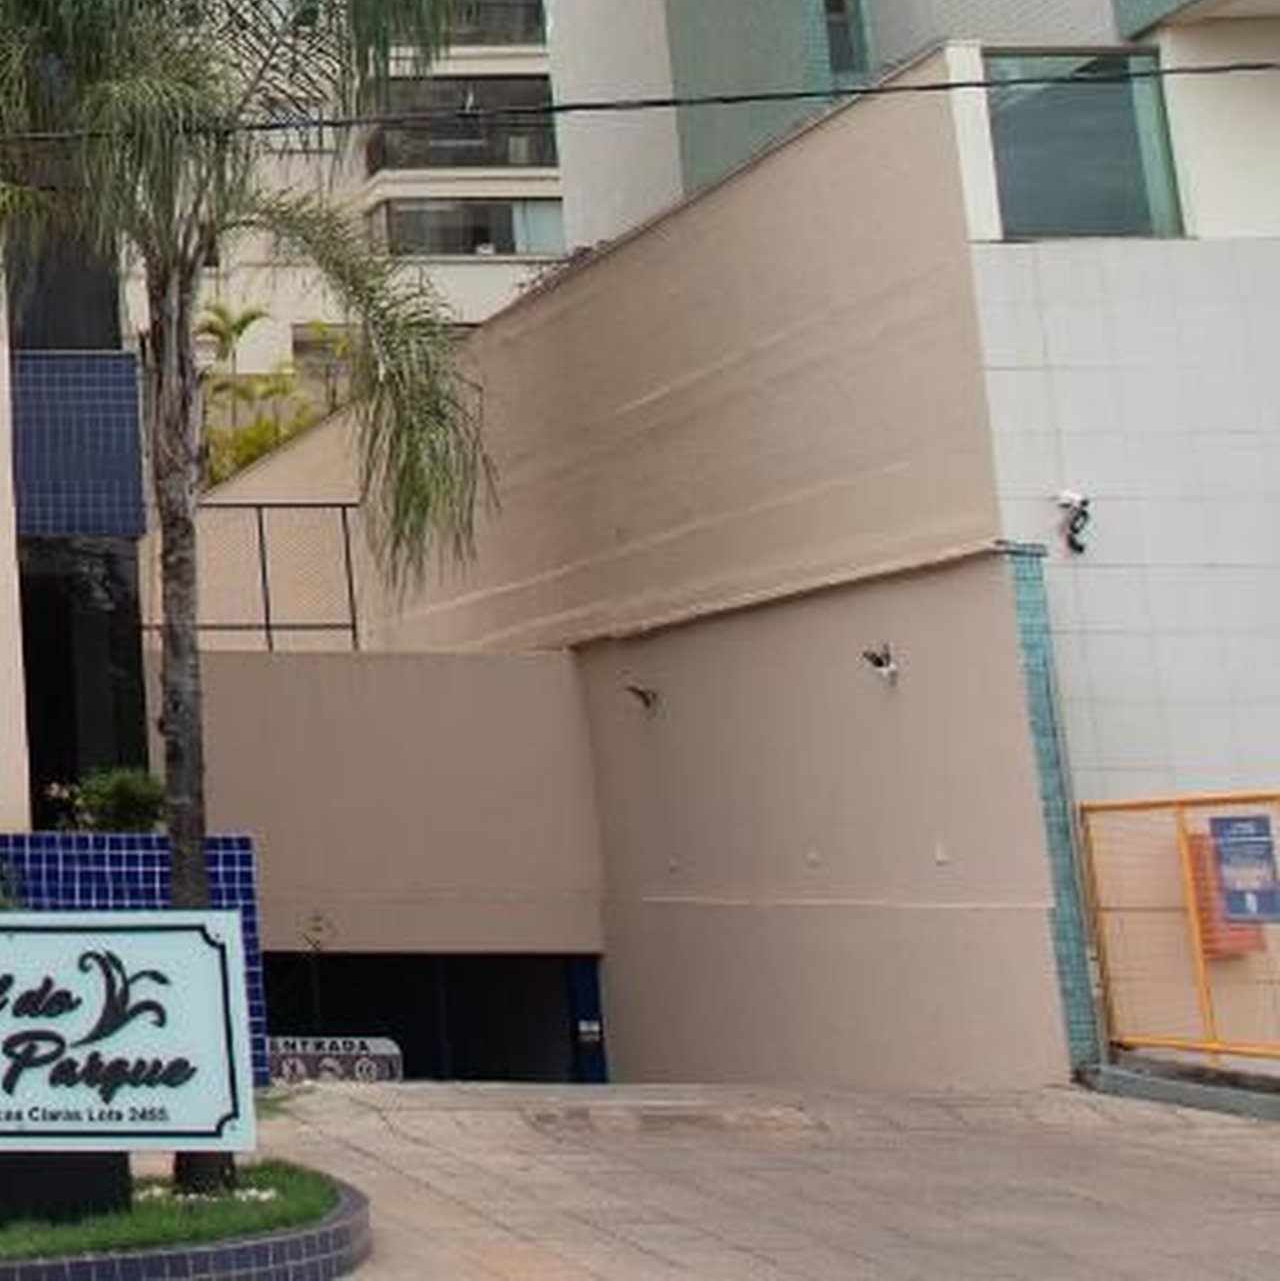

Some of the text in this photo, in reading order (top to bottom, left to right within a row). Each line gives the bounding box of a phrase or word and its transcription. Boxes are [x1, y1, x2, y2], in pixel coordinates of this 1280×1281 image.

[11, 975, 83, 1018] do
[1, 1029, 198, 1105] Parque
[27, 1106, 84, 1122] Claras
